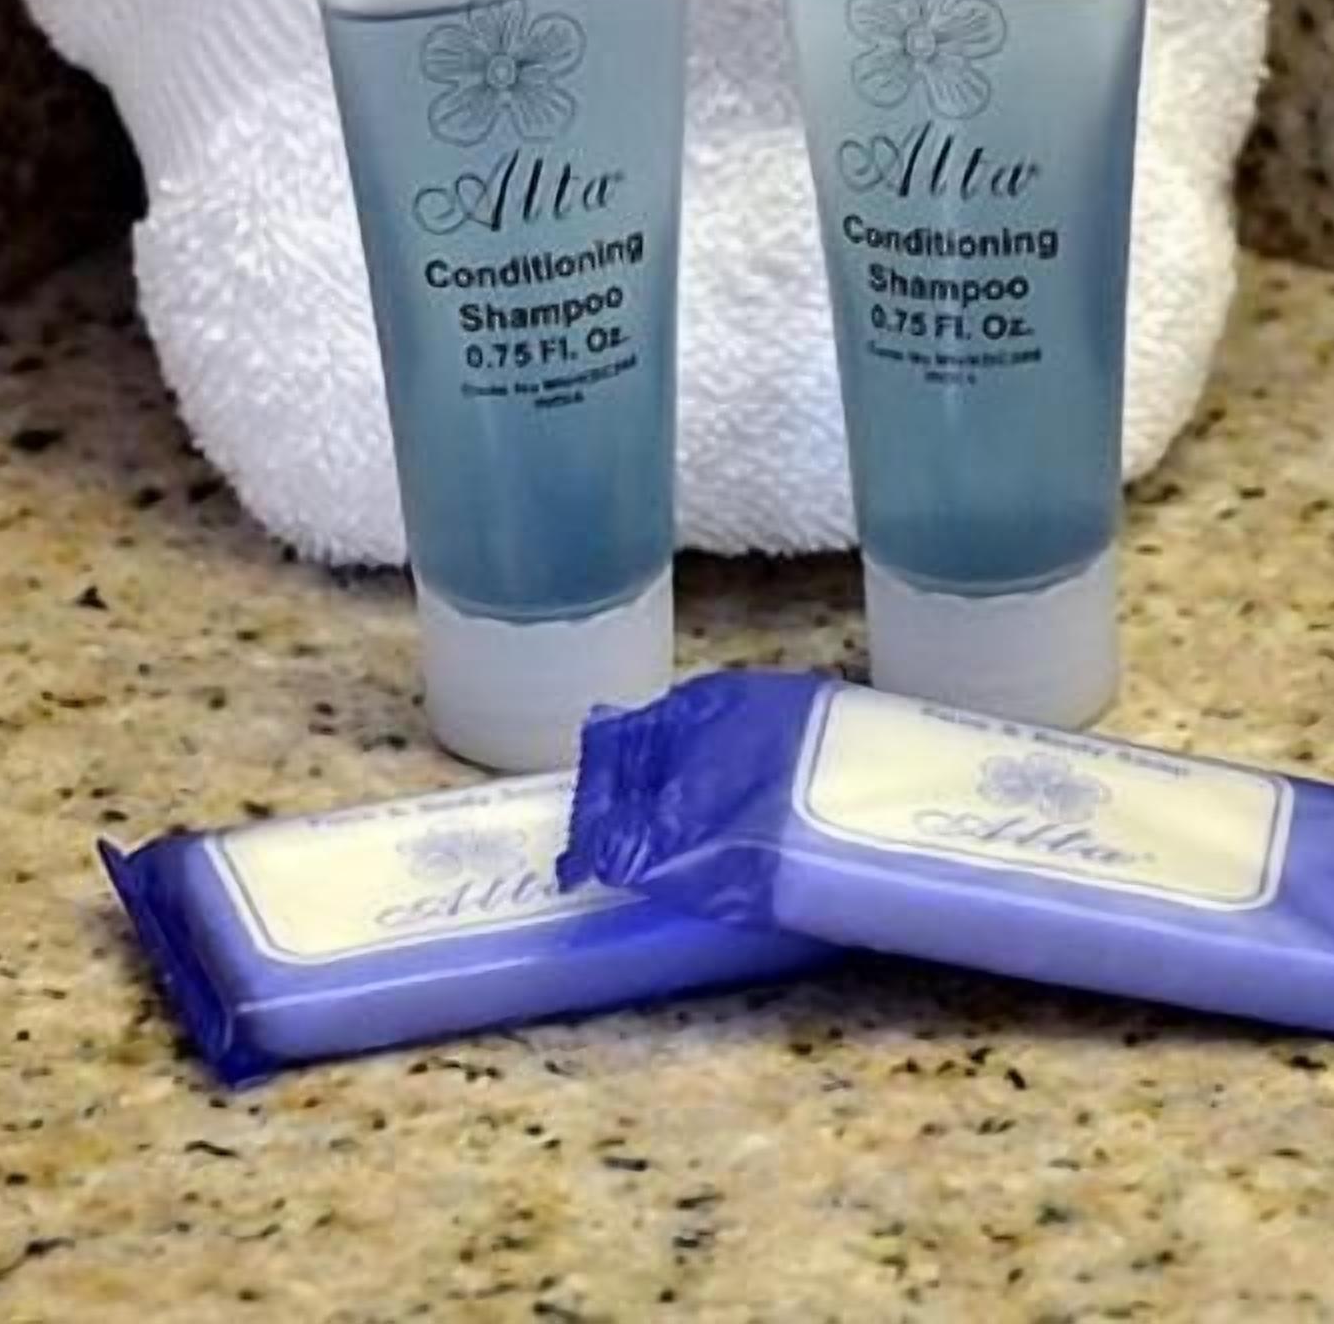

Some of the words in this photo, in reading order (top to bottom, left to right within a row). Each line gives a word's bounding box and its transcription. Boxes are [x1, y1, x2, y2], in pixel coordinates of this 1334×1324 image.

[839, 120, 1040, 200] Alta
[413, 148, 624, 233] Alta
[843, 214, 1060, 258] Conditioning
[425, 232, 645, 288] Conditioning
[869, 264, 1029, 308] Shampoo
[459, 287, 623, 332] Shampoo
[871, 307, 926, 336] 0.75
[935, 314, 971, 340] Fl.
[982, 313, 1034, 340] Oz.
[466, 343, 533, 369] 0.75
[539, 336, 578, 364] Fl.
[913, 808, 1153, 864] Alta
